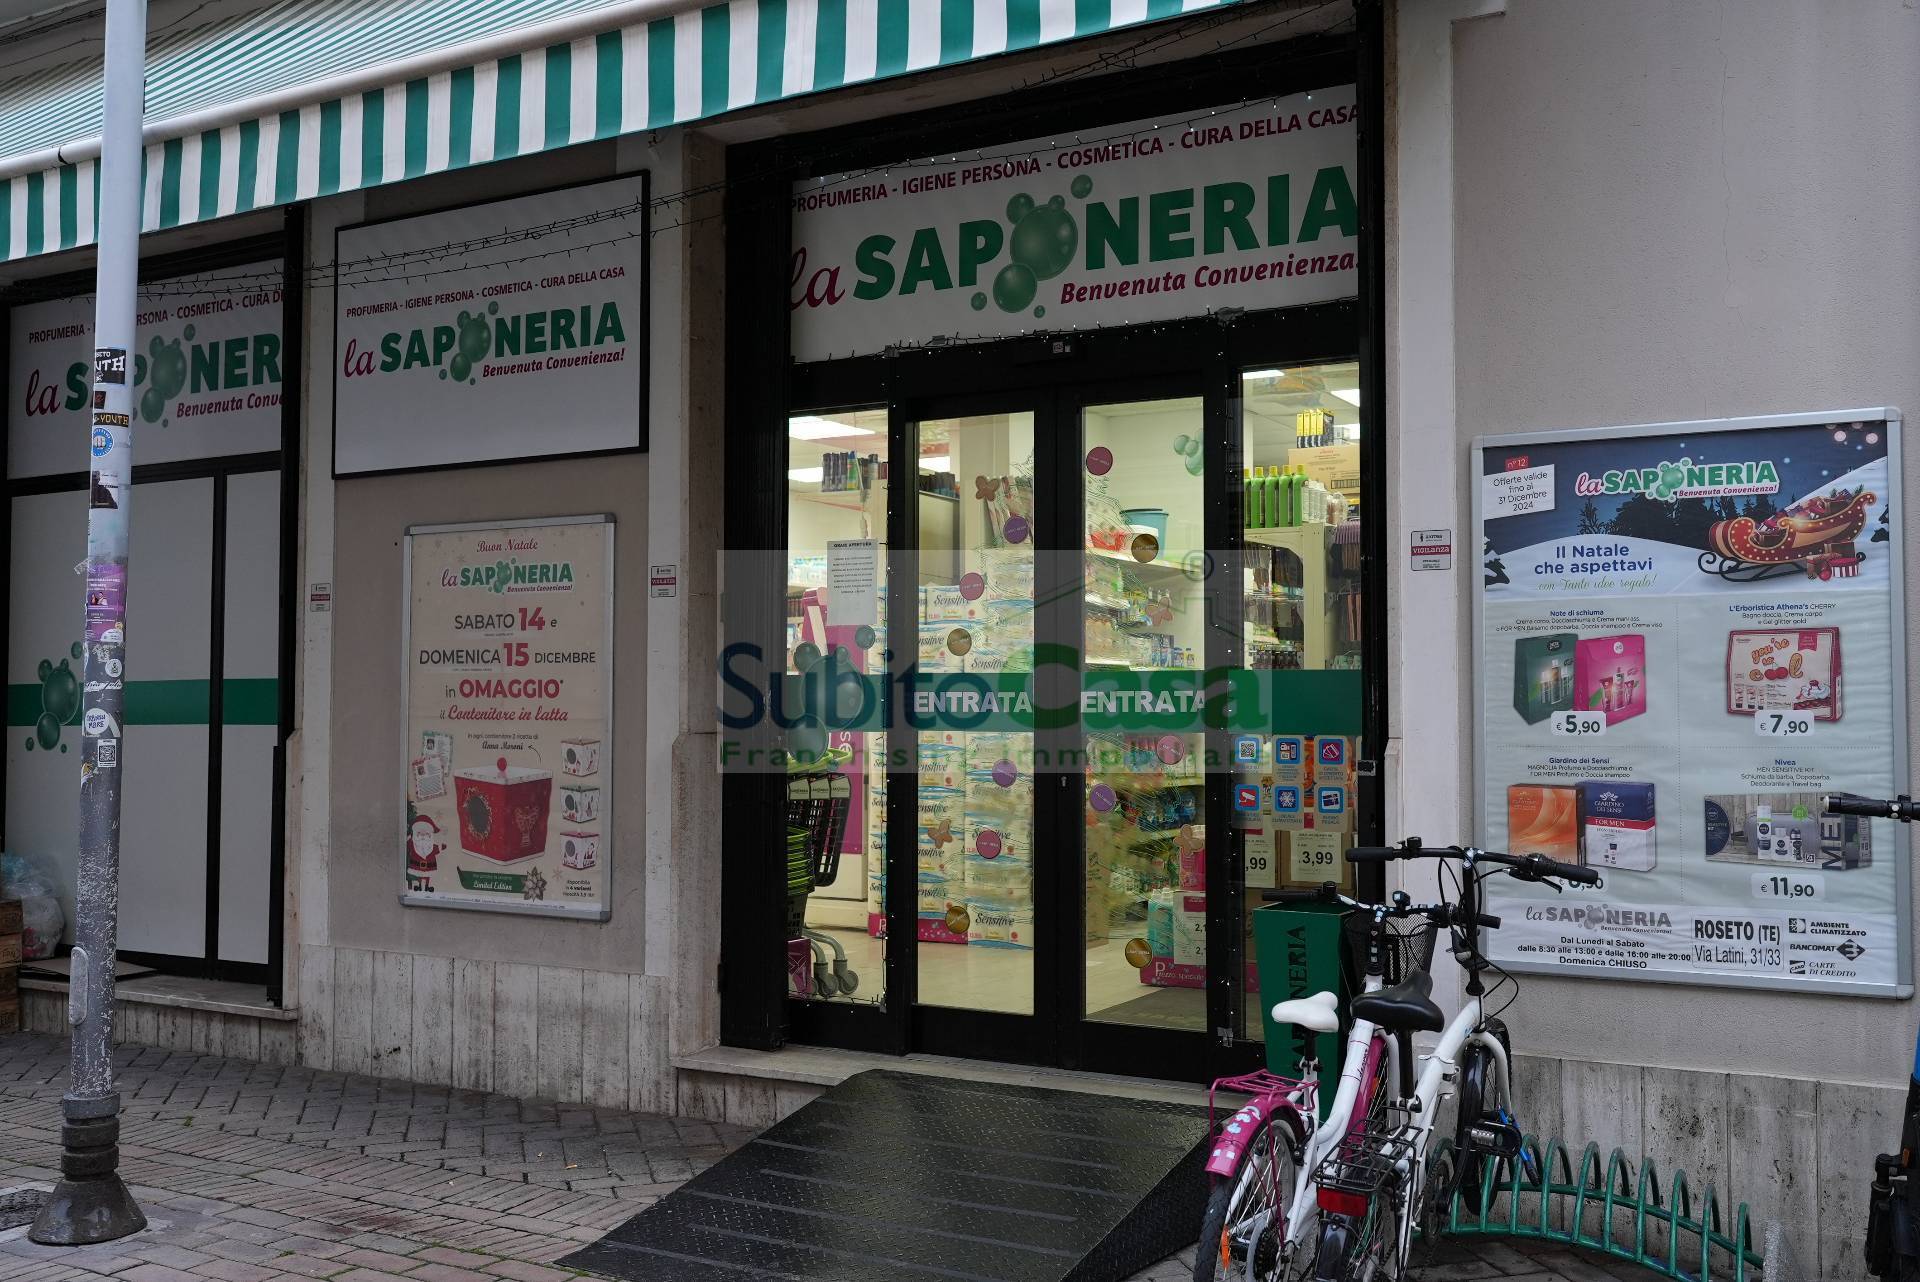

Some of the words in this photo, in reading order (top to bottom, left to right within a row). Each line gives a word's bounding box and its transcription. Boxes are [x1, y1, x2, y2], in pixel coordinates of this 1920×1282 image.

[903, 171, 956, 195] IGIENE
[962, 158, 1041, 186] PERSONA
[1057, 137, 1163, 168] COSMETICA
[1181, 126, 1233, 149] CURA
[1240, 114, 1301, 140] DELLA
[1308, 105, 1359, 128] CASA
[347, 302, 398, 317] PROFUMERIA
[405, 296, 432, 309] IGIENE
[435, 290, 474, 304] PERSONA
[482, 281, 532, 297] COSMETICA
[541, 276, 565, 288] CURA
[568, 271, 597, 284] DELLA
[600, 266, 625, 279] CASA
[1060, 272, 1186, 304] Benvenuta
[29, 324, 85, 344] PROFUMERIA
[177, 299, 233, 319] COSMETICA
[242, 292, 269, 308] CURA
[343, 339, 376, 377] la
[483, 359, 542, 377] Benvenuta
[546, 348, 625, 369] Convenienza!
[25, 369, 60, 416] la
[177, 396, 243, 418] Benvenuta
[1493, 476, 1521, 487] Offerte
[1524, 472, 1547, 481] valide
[1509, 485, 1525, 493] fino
[1527, 482, 1533, 490] al
[1576, 473, 1601, 494] la
[1508, 491, 1547, 503] Dicembre
[1679, 489, 1721, 497] Benvenuta
[1723, 485, 1777, 495] Convenienza!
[1512, 501, 1533, 511] 2024
[477, 540, 501, 552] Buon
[505, 538, 538, 551] Natale
[1556, 547, 1565, 558] Il
[1572, 544, 1629, 558] Natale
[1535, 562, 1564, 574] che
[1570, 558, 1652, 575] aspettavi
[441, 569, 457, 587] la
[1729, 604, 1775, 612] L'Erboristica
[454, 613, 515, 630] SABATO
[519, 607, 546, 631] 14
[551, 618, 557, 628] e
[419, 650, 501, 665] DOMENICA
[504, 643, 529, 667] 15
[534, 652, 596, 663] DICEMBRE
[445, 684, 456, 698] in
[914, 691, 1032, 713] ENTRATA
[448, 705, 515, 720] Contenitore
[519, 708, 531, 720] in
[535, 706, 568, 721] latta
[1565, 715, 1600, 735] 5,90
[1770, 715, 1809, 736] 7,90
[1302, 851, 1333, 866] 3,99
[1761, 884, 1767, 892] €
[1770, 877, 1814, 898] 11,90
[975, 913, 1015, 926] Sensitive
[1526, 905, 1543, 921] la
[1600, 925, 1631, 933] Benvenuta
[1694, 919, 1754, 940] ROSETO
[1758, 925, 1781, 945] (TE)
[1810, 921, 1849, 929] AMBIENTE
[1810, 928, 1866, 937] CLIMATIZZATO
[1561, 936, 1574, 944] Dal
[1606, 938, 1613, 946] al
[1616, 939, 1645, 949] Sabato
[1790, 944, 1836, 952] BANCOMAT
[1560, 956, 1606, 967] Domenica
[1608, 959, 1647, 969] CHIUSO
[1627, 951, 1649, 959] 16:00
[1651, 952, 1666, 960] alle
[1668, 953, 1691, 961] 20:00
[1694, 945, 1712, 961] Via
[1716, 946, 1747, 967] Latini,
[1750, 947, 1781, 966] 31/33
[1809, 961, 1836, 969] CARTE
